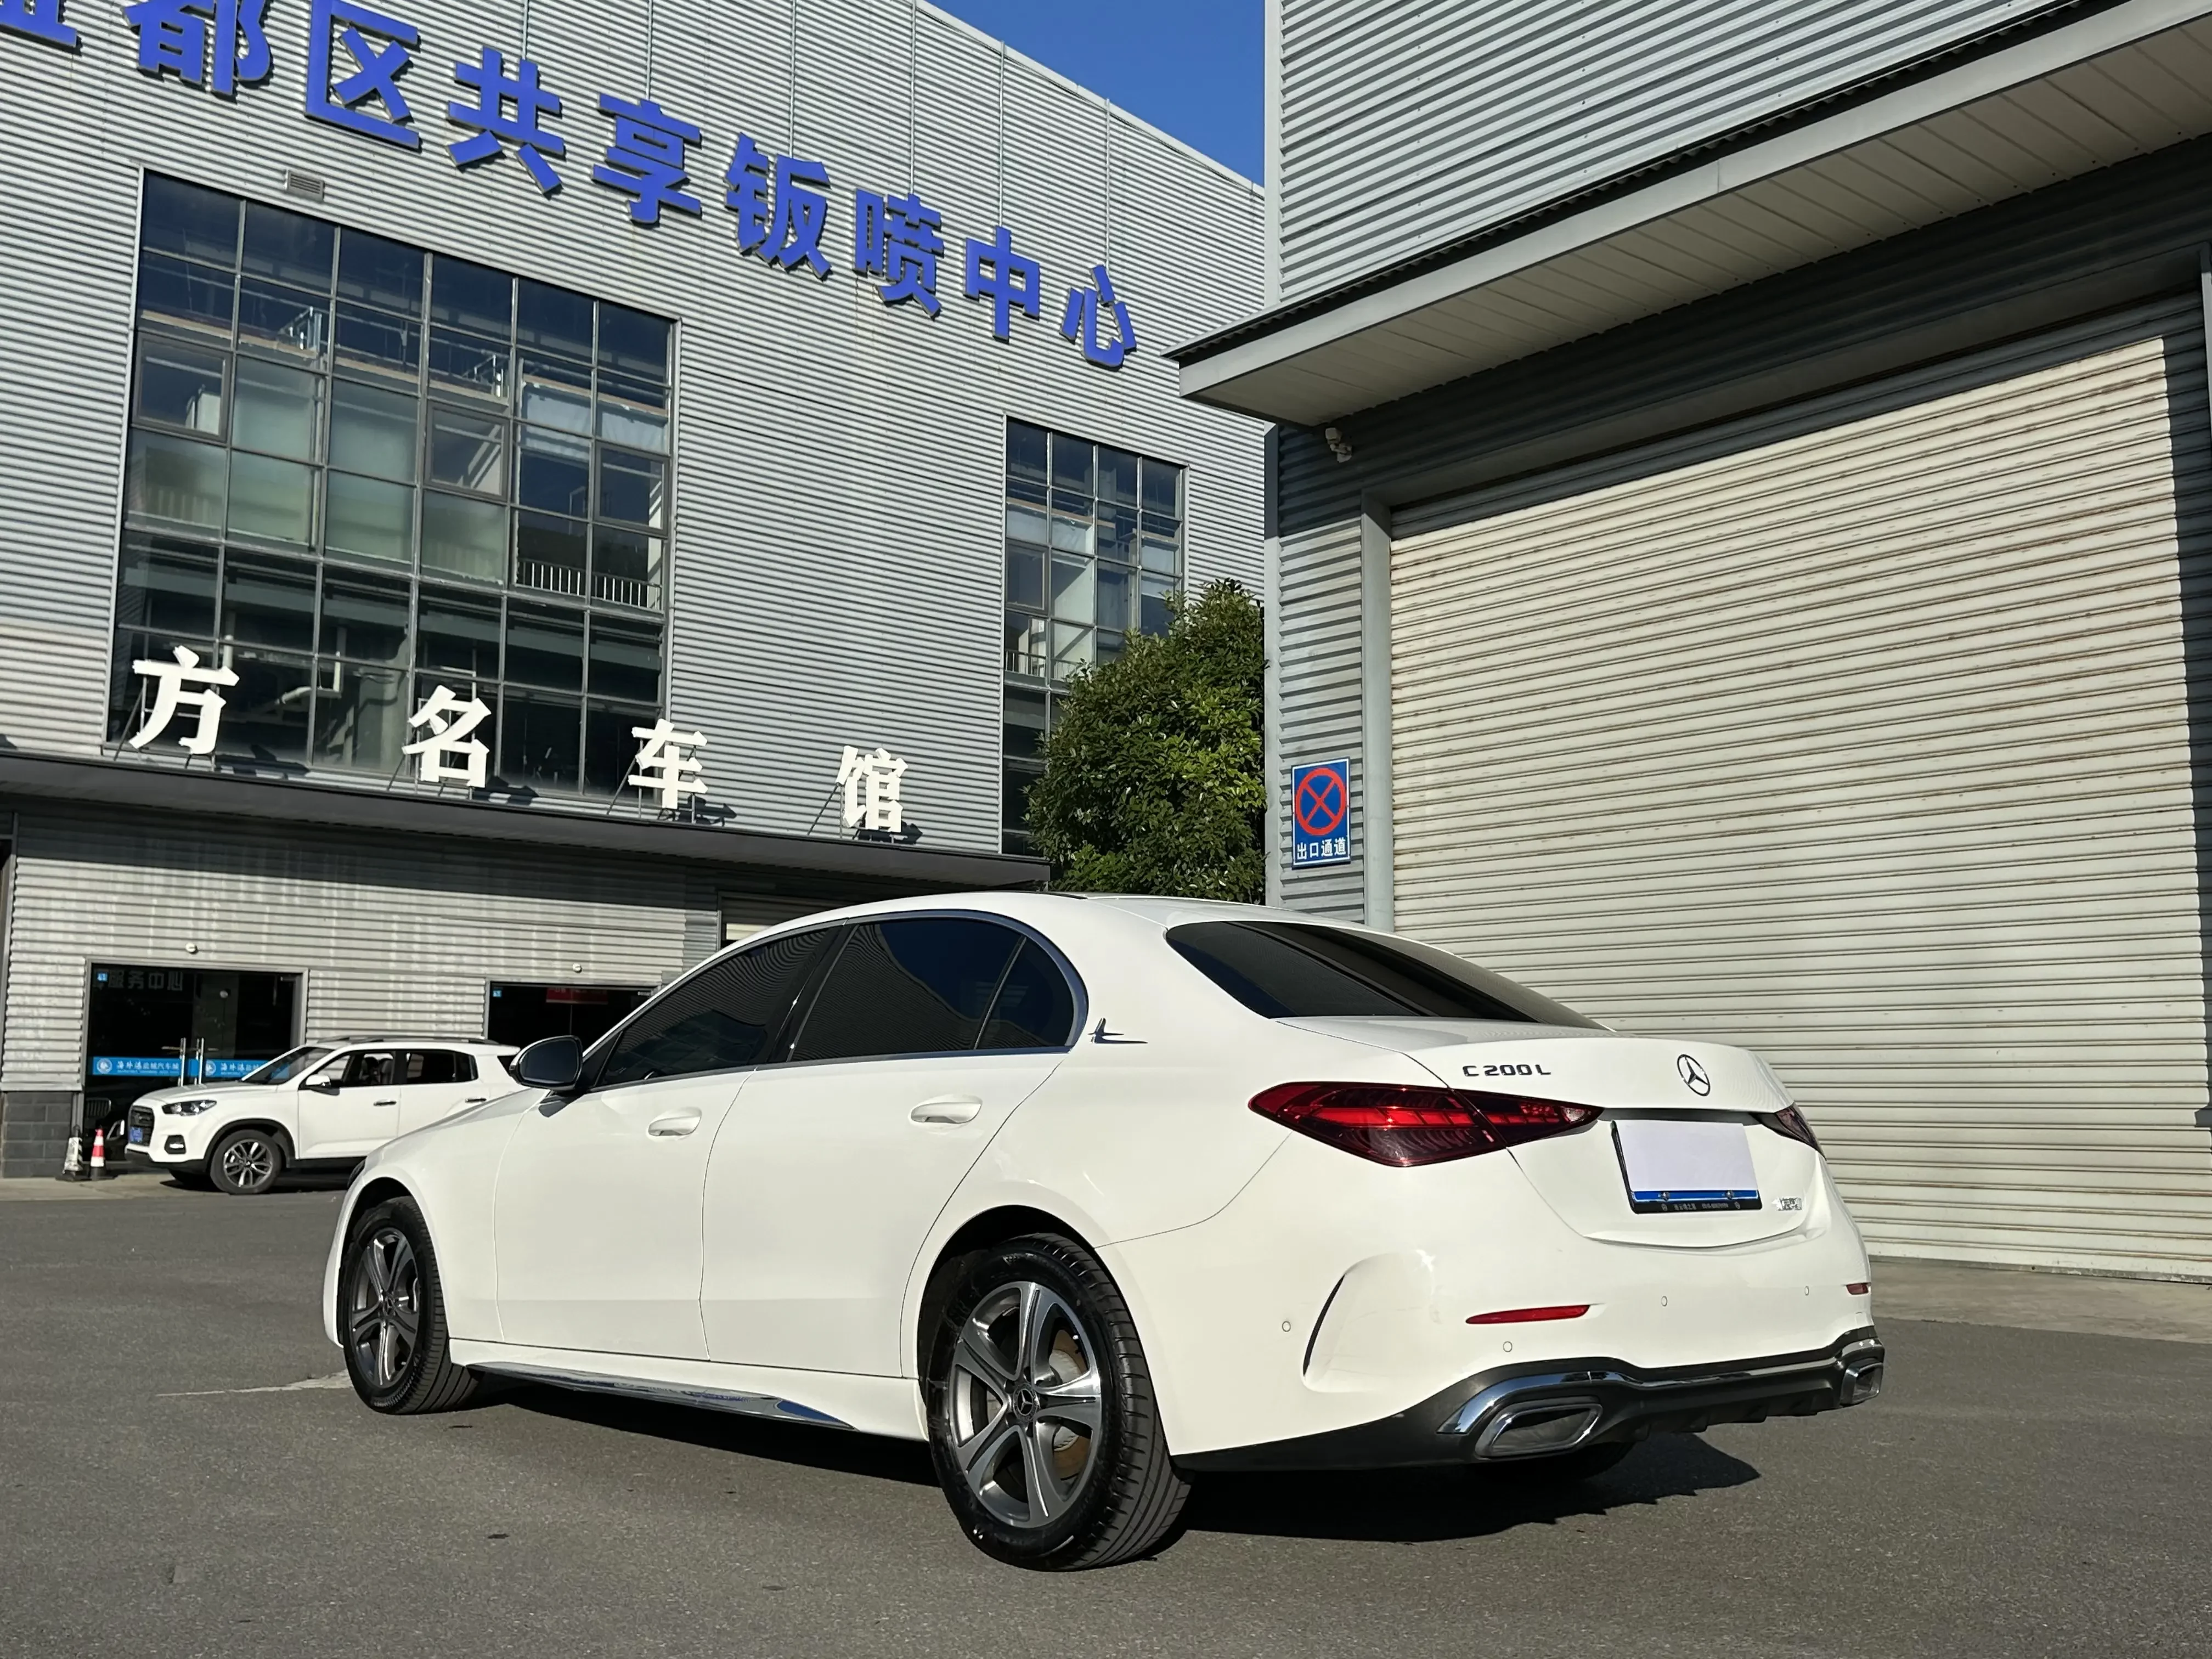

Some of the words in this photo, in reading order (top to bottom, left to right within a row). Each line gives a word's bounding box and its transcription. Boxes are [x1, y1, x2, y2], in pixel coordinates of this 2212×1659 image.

[128, 644, 909, 833] 方名车馆
[1296, 837, 1346, 860] 出口通道
